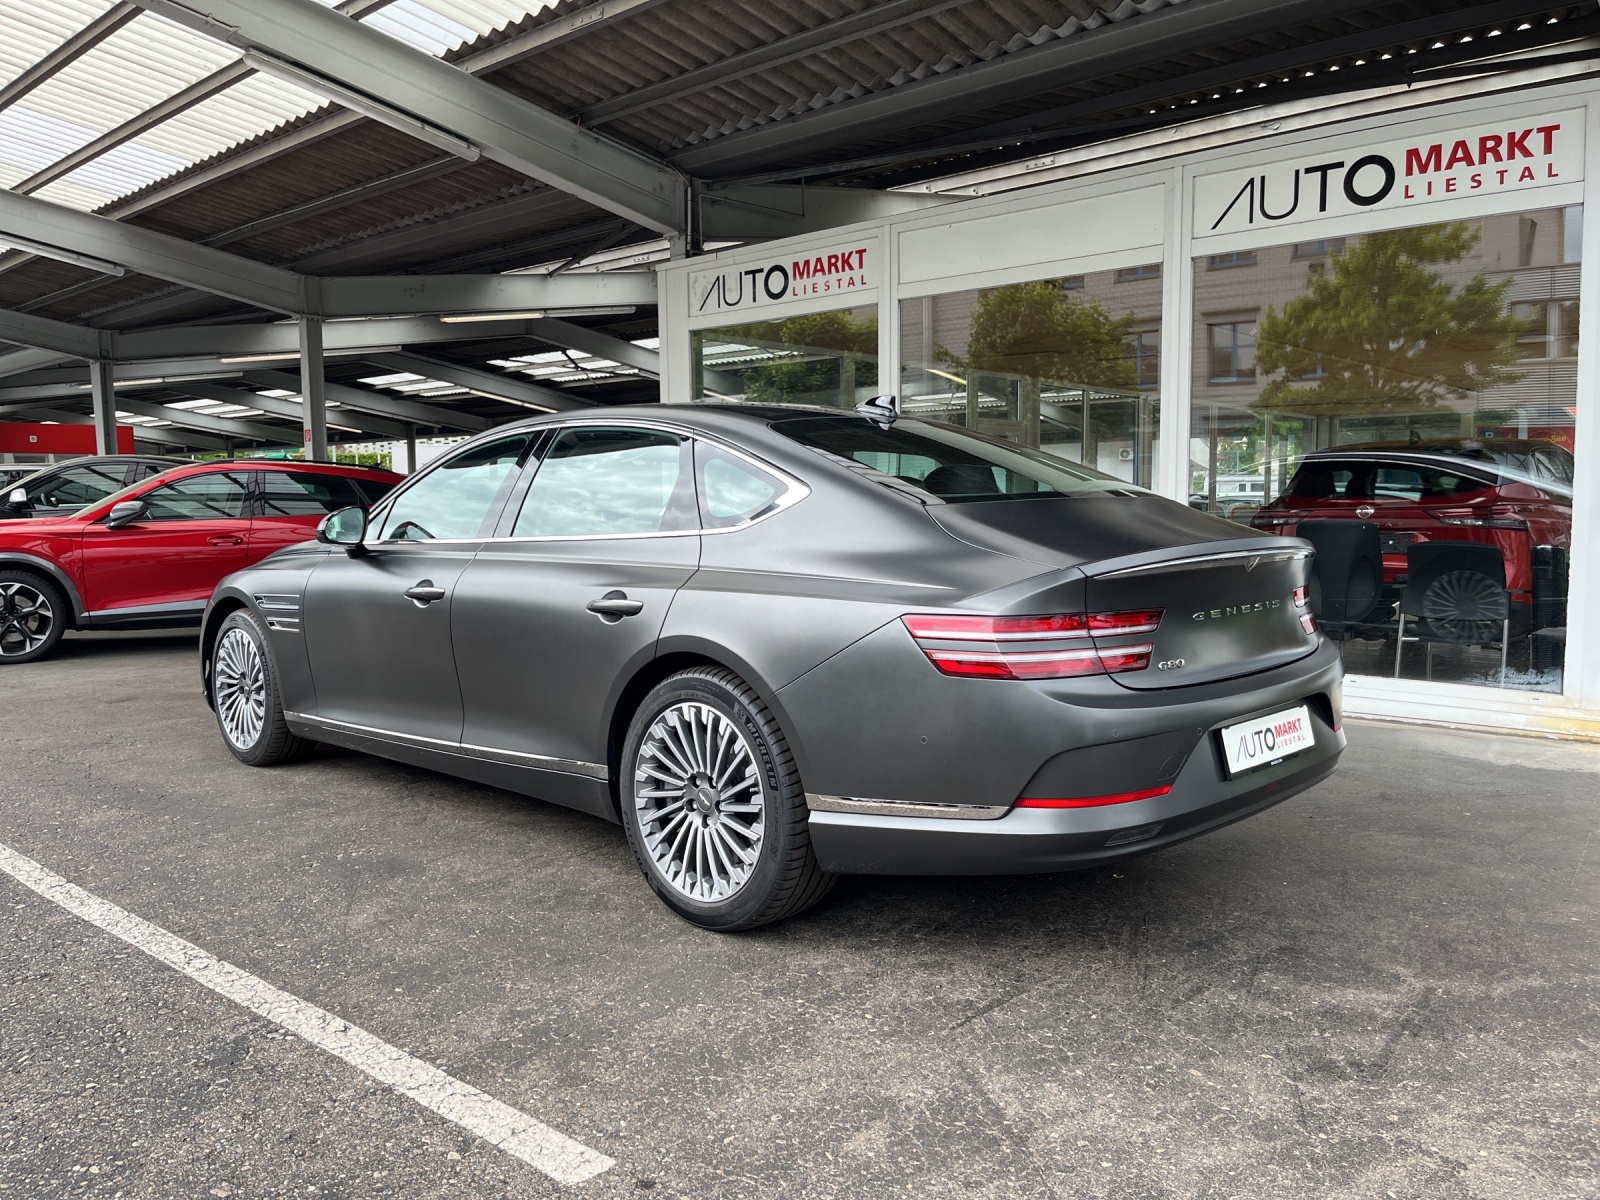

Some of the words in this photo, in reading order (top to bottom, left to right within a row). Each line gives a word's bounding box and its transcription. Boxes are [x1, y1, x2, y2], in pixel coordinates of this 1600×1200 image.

[1210, 154, 1396, 230] AUTO
[1404, 123, 1561, 178] MARKT
[1403, 162, 1559, 200] LIESTAL
[698, 264, 790, 312] AUTO
[792, 248, 867, 282] MARKT
[792, 274, 867, 297] LIESTAL
[1192, 599, 1280, 621] GENESIS
[1157, 658, 1186, 671] G80
[746, 722, 777, 787] MICHELIN
[1236, 727, 1276, 763] AUTO
[1273, 717, 1302, 739] MARKT
[1276, 733, 1306, 749] LIESTAL
